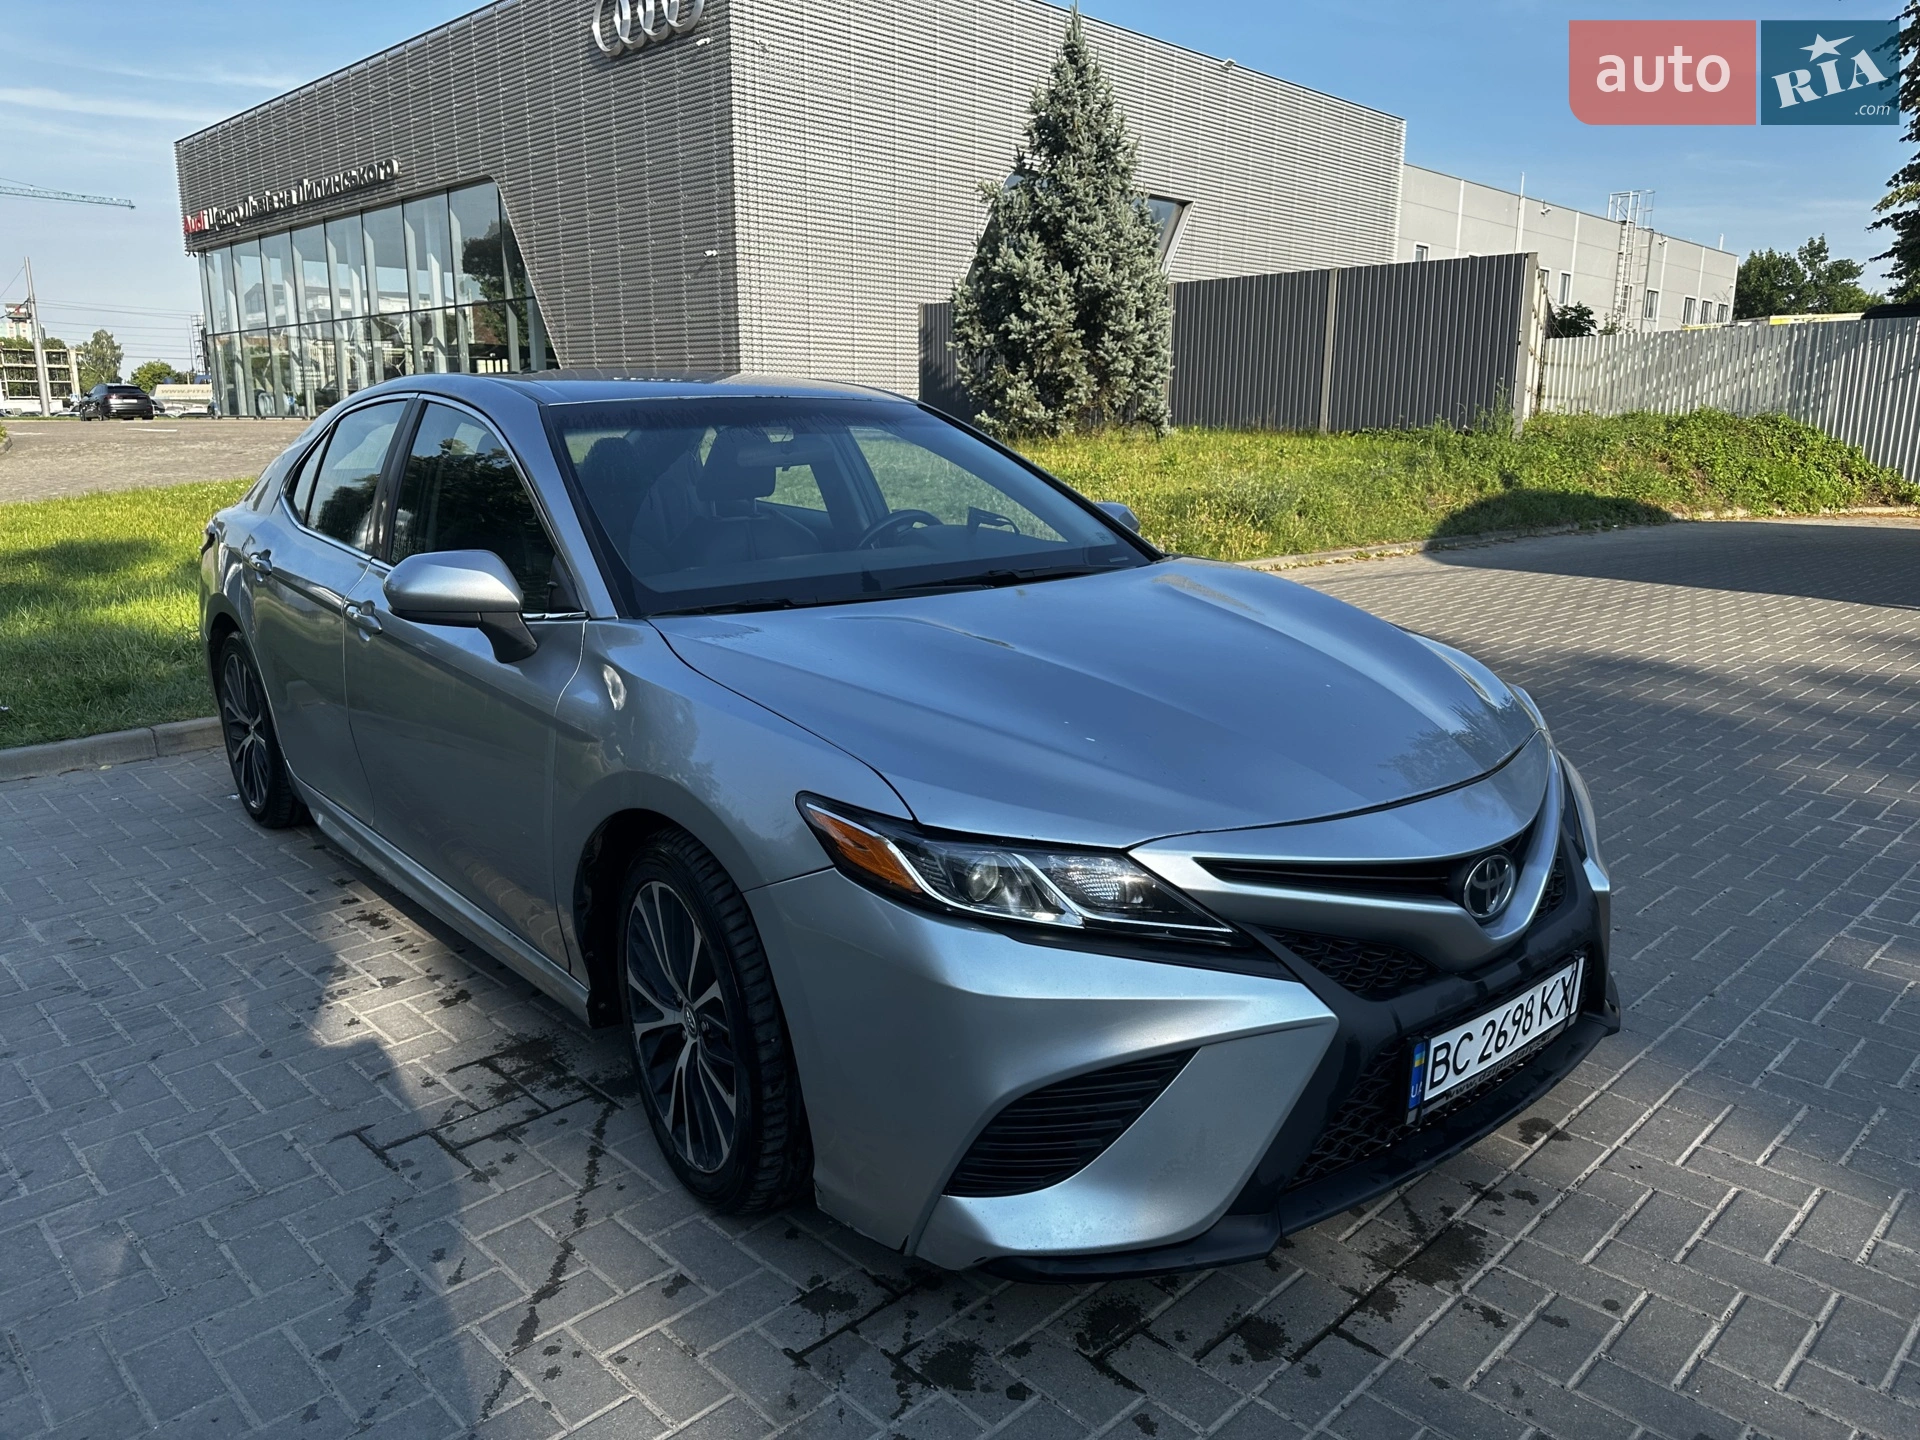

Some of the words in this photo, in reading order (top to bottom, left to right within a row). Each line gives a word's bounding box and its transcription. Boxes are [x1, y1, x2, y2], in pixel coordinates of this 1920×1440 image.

[184, 209, 208, 234] Audi
[1428, 1031, 1474, 1091] BC
[1477, 994, 1535, 1065] 2698
[1538, 970, 1576, 1027] KX
